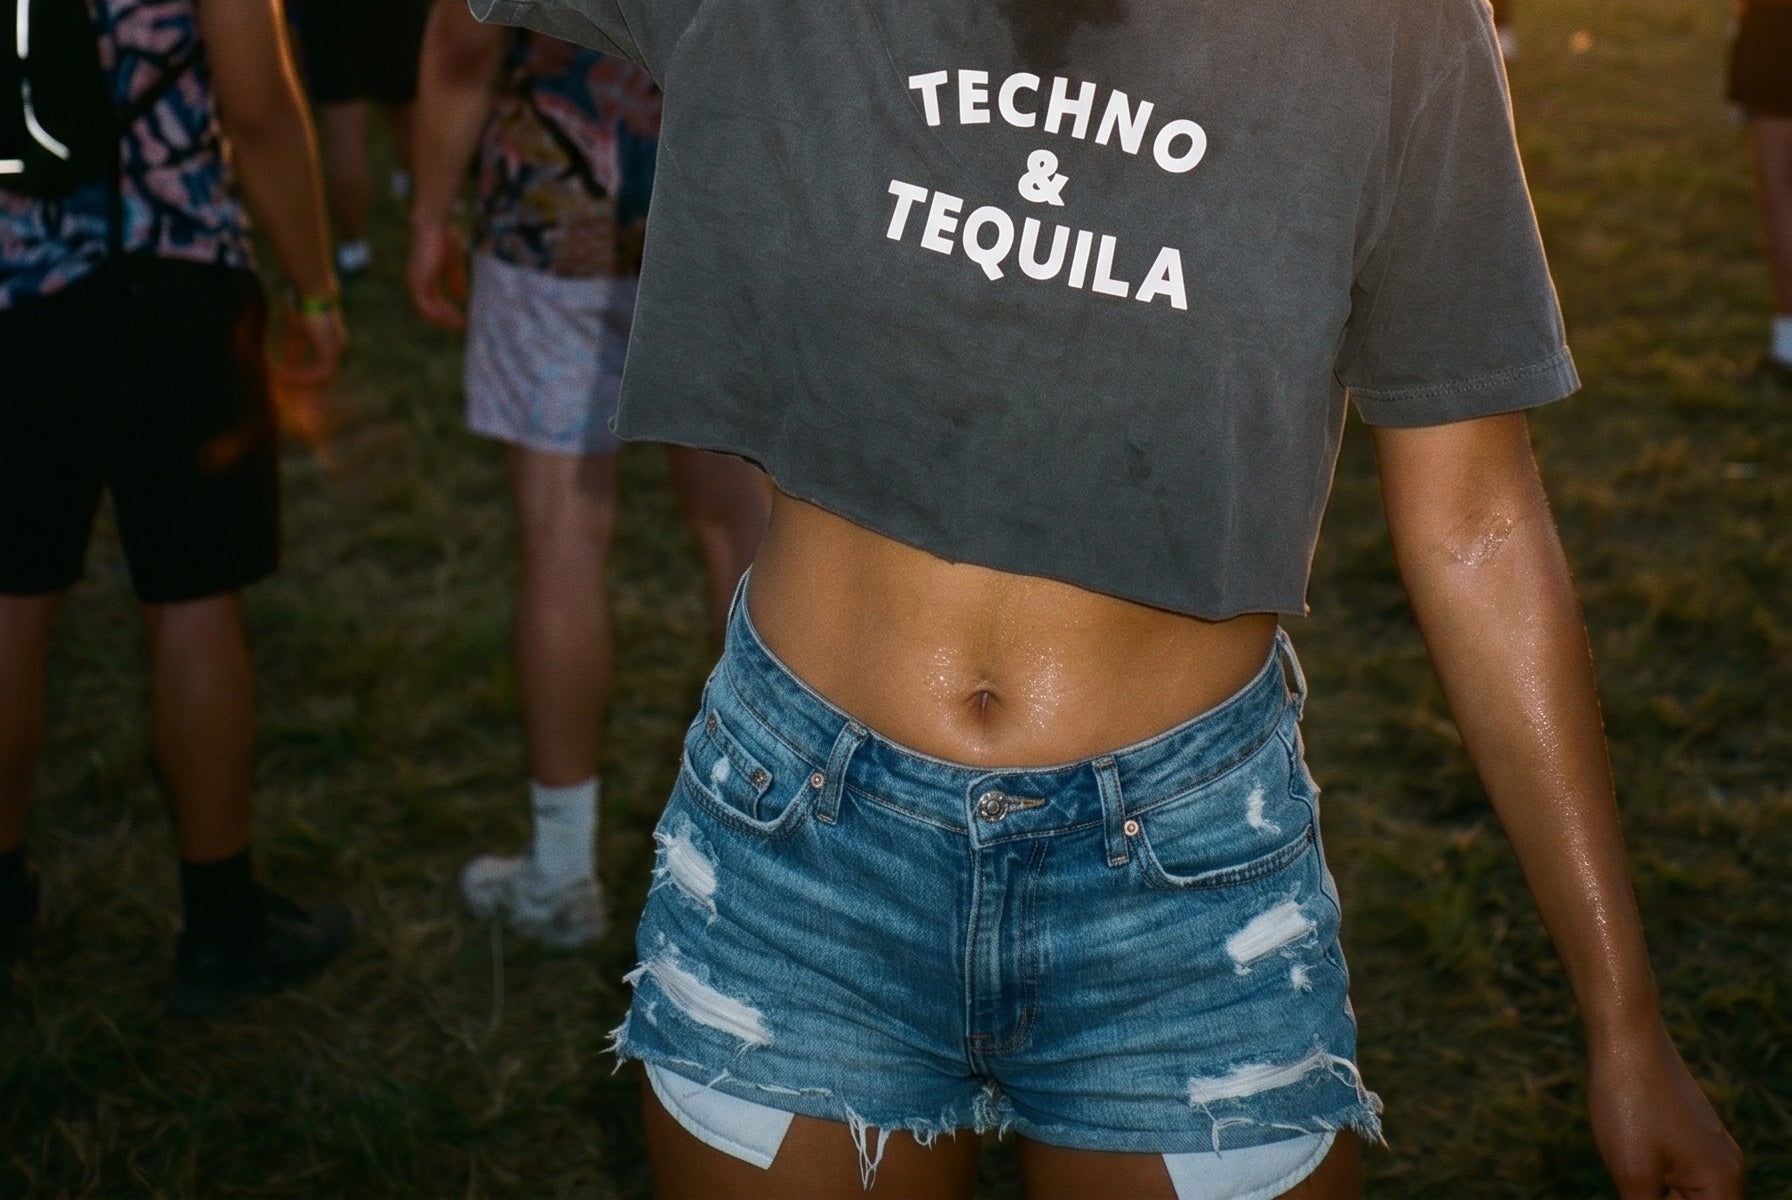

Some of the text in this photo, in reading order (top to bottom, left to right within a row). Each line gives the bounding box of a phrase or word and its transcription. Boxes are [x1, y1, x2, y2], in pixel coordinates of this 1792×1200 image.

[908, 69, 1207, 174] TECHNO
[1017, 149, 1070, 207] &
[886, 179, 1188, 311] TEQUILA
